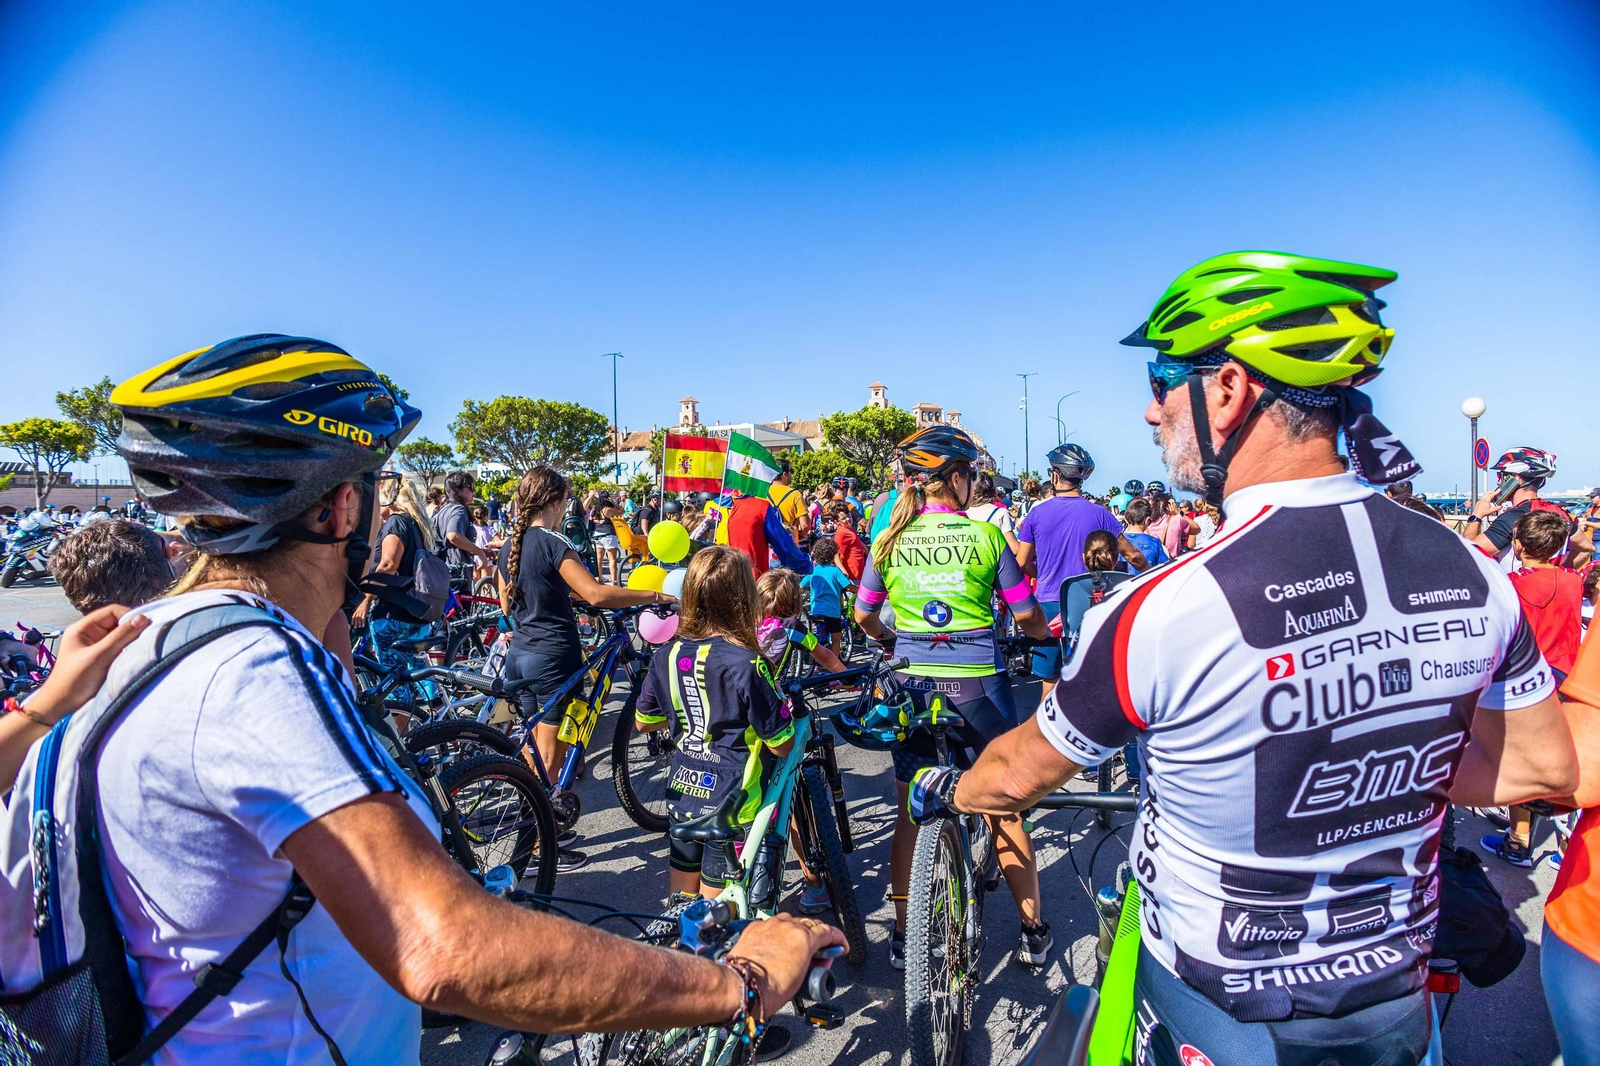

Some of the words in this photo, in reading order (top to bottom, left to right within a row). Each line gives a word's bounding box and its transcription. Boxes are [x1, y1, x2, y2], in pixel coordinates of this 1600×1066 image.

[1209, 301, 1274, 331] ORBEA
[318, 416, 372, 446] GIRO
[938, 534, 979, 544] DENTAL
[888, 546, 983, 568] INNOVA
[1265, 571, 1356, 602] Cascades
[1408, 588, 1471, 606] SHIMANO
[1284, 595, 1359, 638] AQUAFINA
[1301, 617, 1486, 670] GARNEAU
[1261, 663, 1375, 733] Club
[1421, 656, 1495, 681] Chaussures
[1287, 731, 1465, 818] BMC
[1224, 912, 1303, 943] Vittoria
[1221, 946, 1403, 994] SHIMANO
